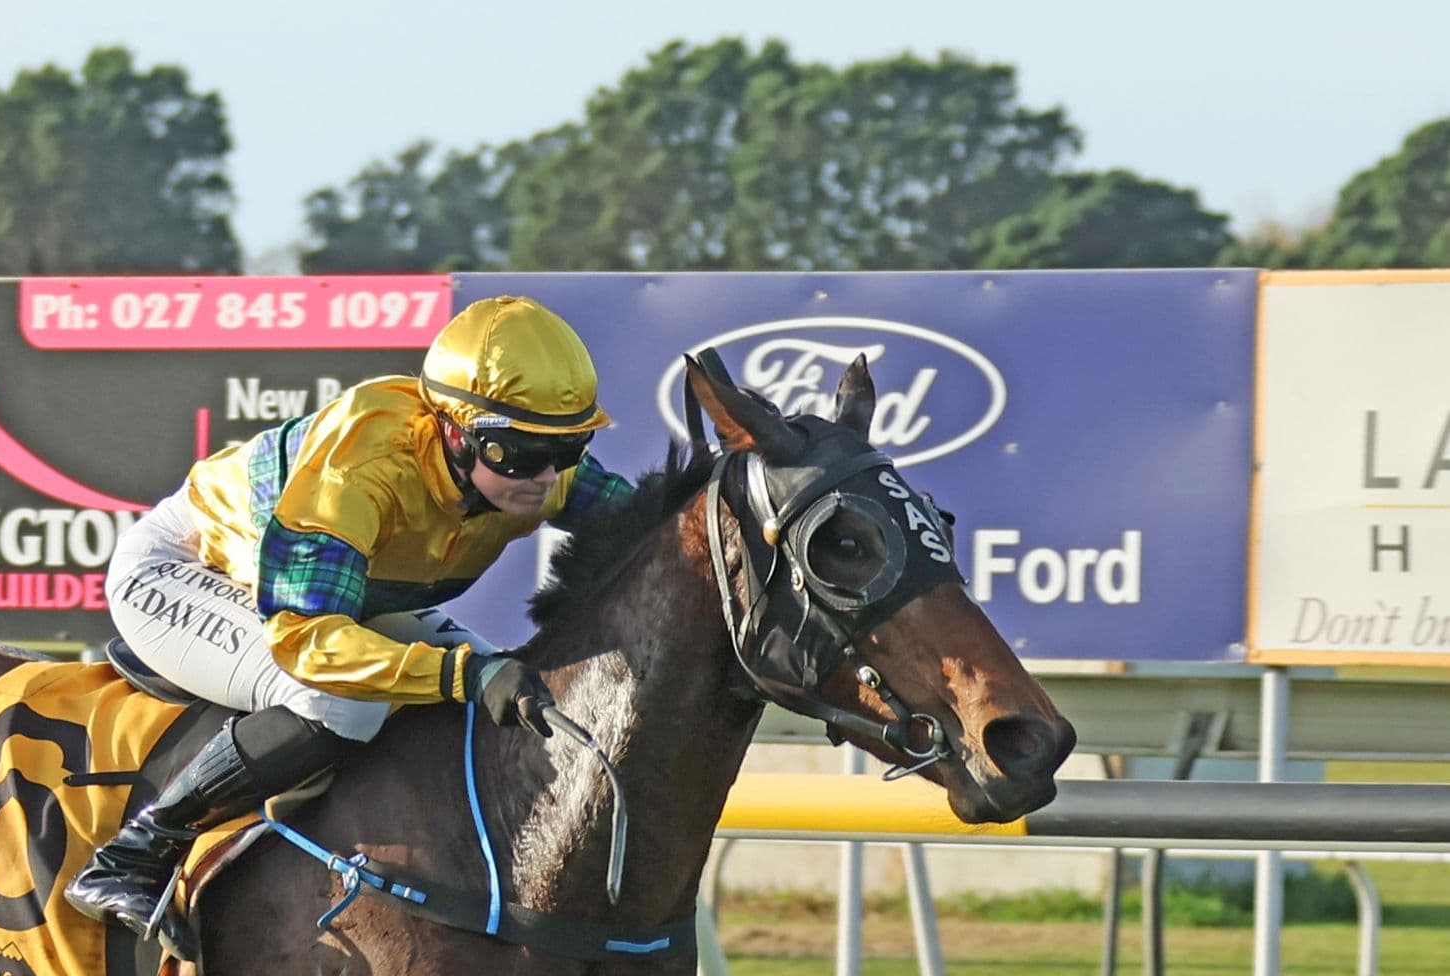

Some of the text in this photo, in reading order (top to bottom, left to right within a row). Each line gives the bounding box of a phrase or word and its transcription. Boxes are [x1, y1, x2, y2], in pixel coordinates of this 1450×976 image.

[31, 291, 440, 330] Ph: 027 845 1097
[226, 376, 308, 421] New
[151, 560, 260, 615] QUIWORL
[972, 529, 1143, 606] Ford
